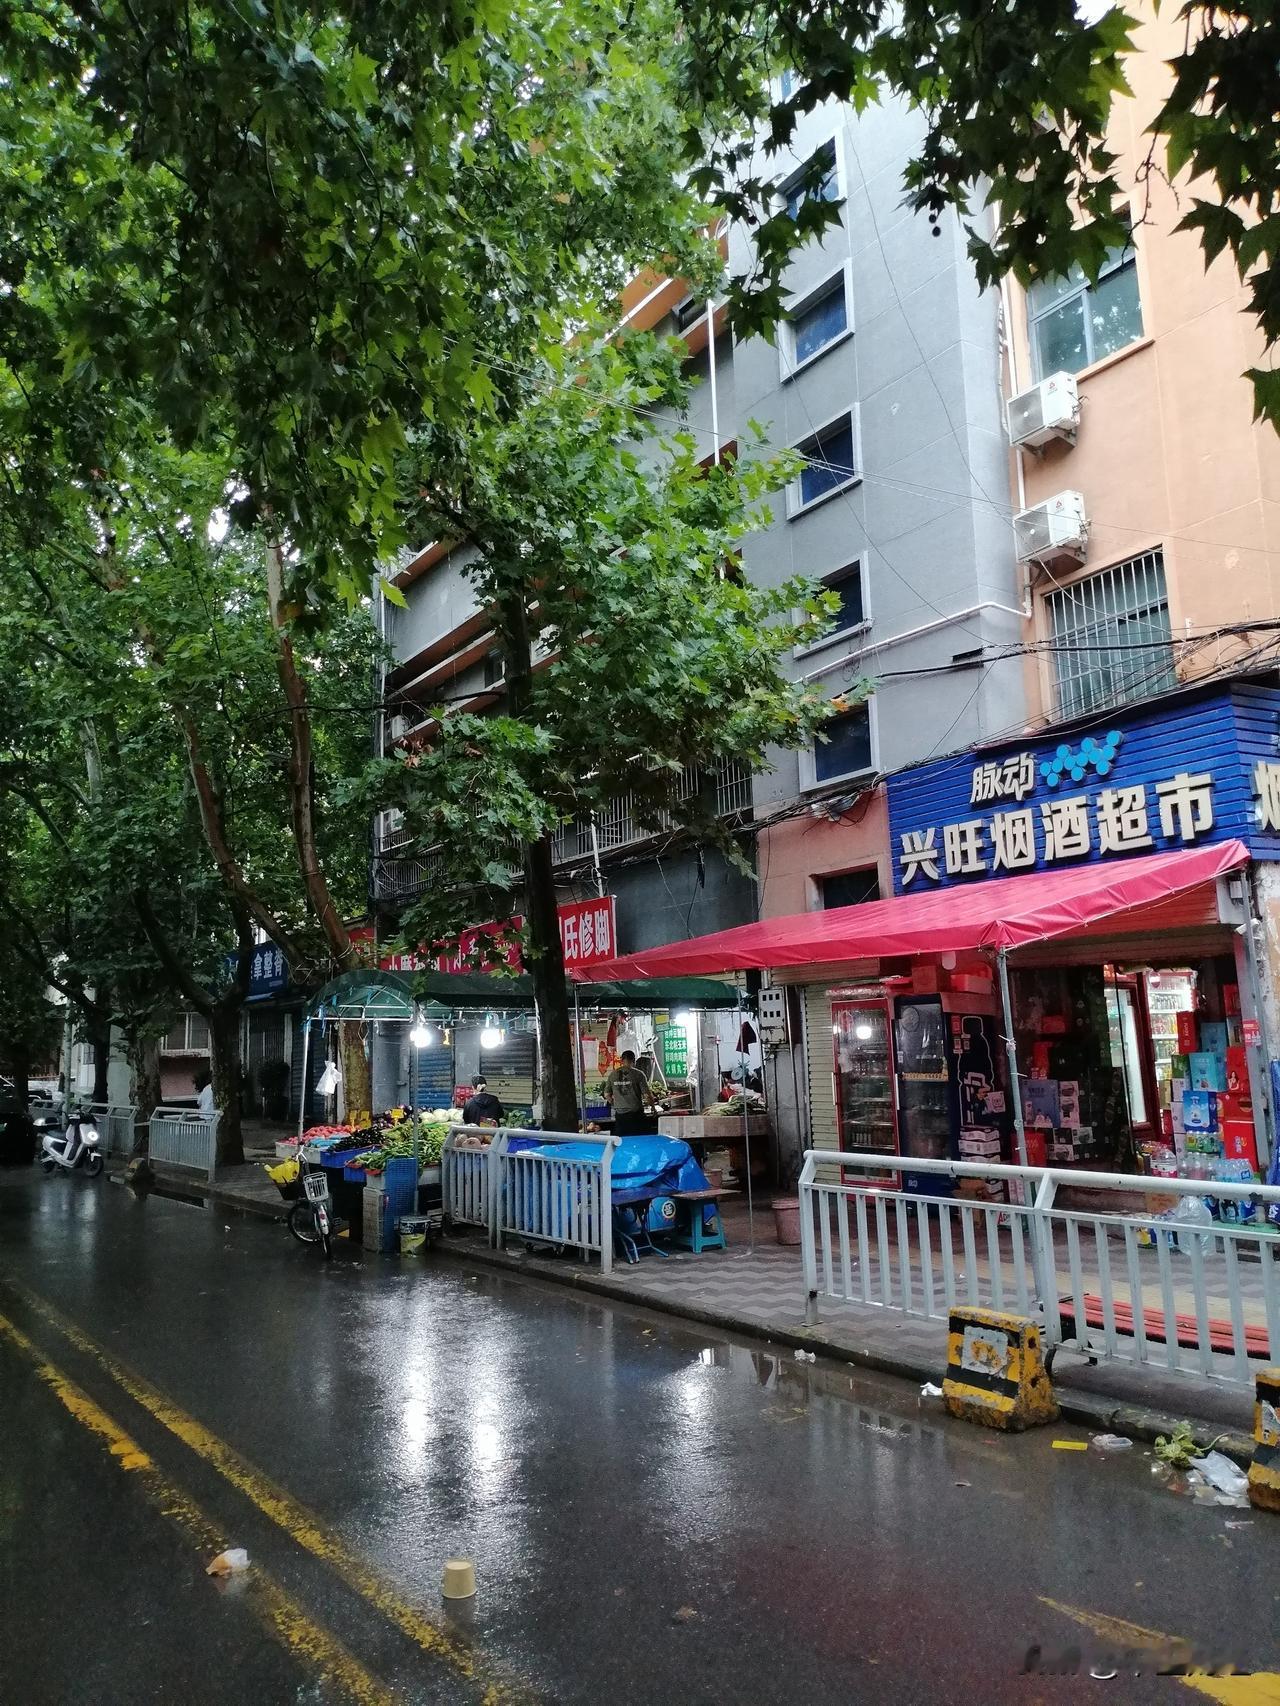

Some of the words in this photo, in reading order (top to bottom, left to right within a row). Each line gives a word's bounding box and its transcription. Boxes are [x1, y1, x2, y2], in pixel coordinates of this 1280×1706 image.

[970, 752, 1034, 803] 脉动
[900, 773, 1214, 885] 兴旺烟酒超市
[559, 908, 610, 960] 氏修脚
[250, 948, 283, 980] 拿整脊
